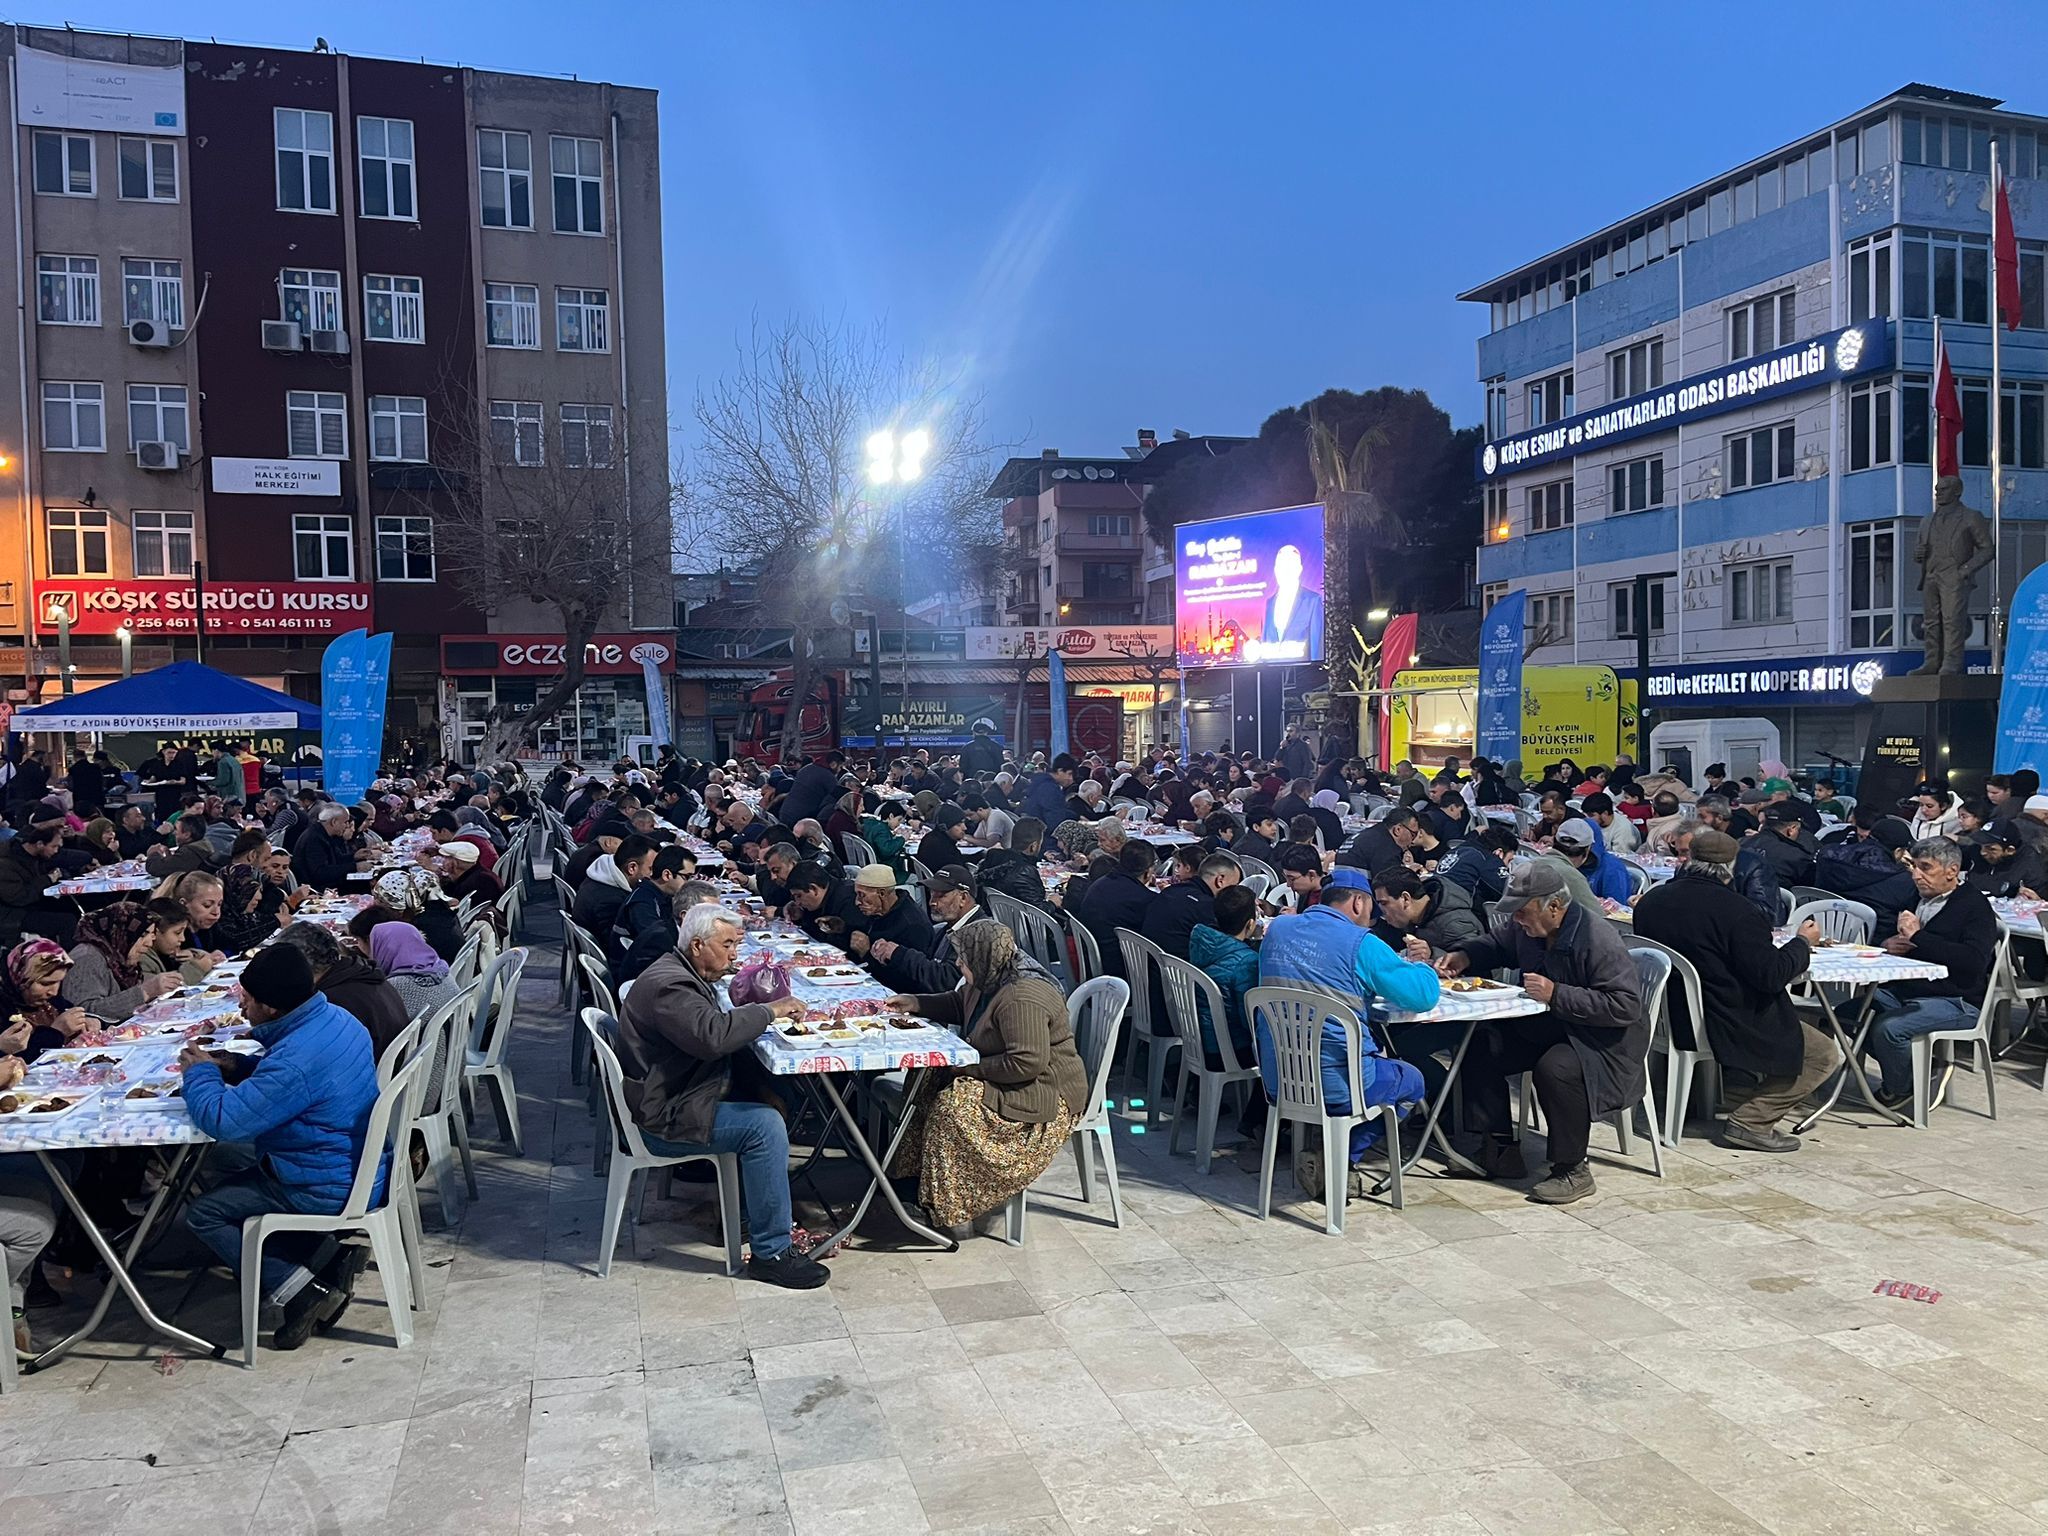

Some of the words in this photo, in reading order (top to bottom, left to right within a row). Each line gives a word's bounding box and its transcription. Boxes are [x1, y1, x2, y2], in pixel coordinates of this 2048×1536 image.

[1500, 439, 1529, 464] KÖŞK
[1531, 427, 1567, 455] ESNAF
[1568, 425, 1583, 445] ve
[1585, 393, 1676, 440] SANATKARLAR
[1678, 377, 1725, 412] ODASI
[1727, 342, 1826, 398] BAŞKANLIĞI
[284, 472, 321, 480] EĞİTİMİ
[255, 481, 299, 489] MERKEZİ
[83, 587, 158, 612] KÖŞK
[165, 588, 275, 609] SÜRÜCÜ
[283, 593, 368, 610] KURSU
[123, 618, 134, 628] 0
[137, 618, 163, 627] 256
[166, 618, 189, 627] 461
[207, 618, 221, 627] 13
[240, 619, 250, 628] 0
[254, 619, 275, 628] 541
[279, 619, 301, 628] 461
[304, 619, 315, 628] 11
[318, 619, 332, 628] 13
[1676, 677, 1691, 694] ve
[1691, 672, 1748, 695] KEFALET
[113, 717, 187, 729] BÜYÜKŞEHİR
[189, 718, 242, 727] BELEDİYESİ
[1555, 724, 1580, 732] AYDIN
[1521, 733, 1595, 746] BÜYÜKŞEHİR
[1535, 747, 1582, 755] BELEDİYESİ
